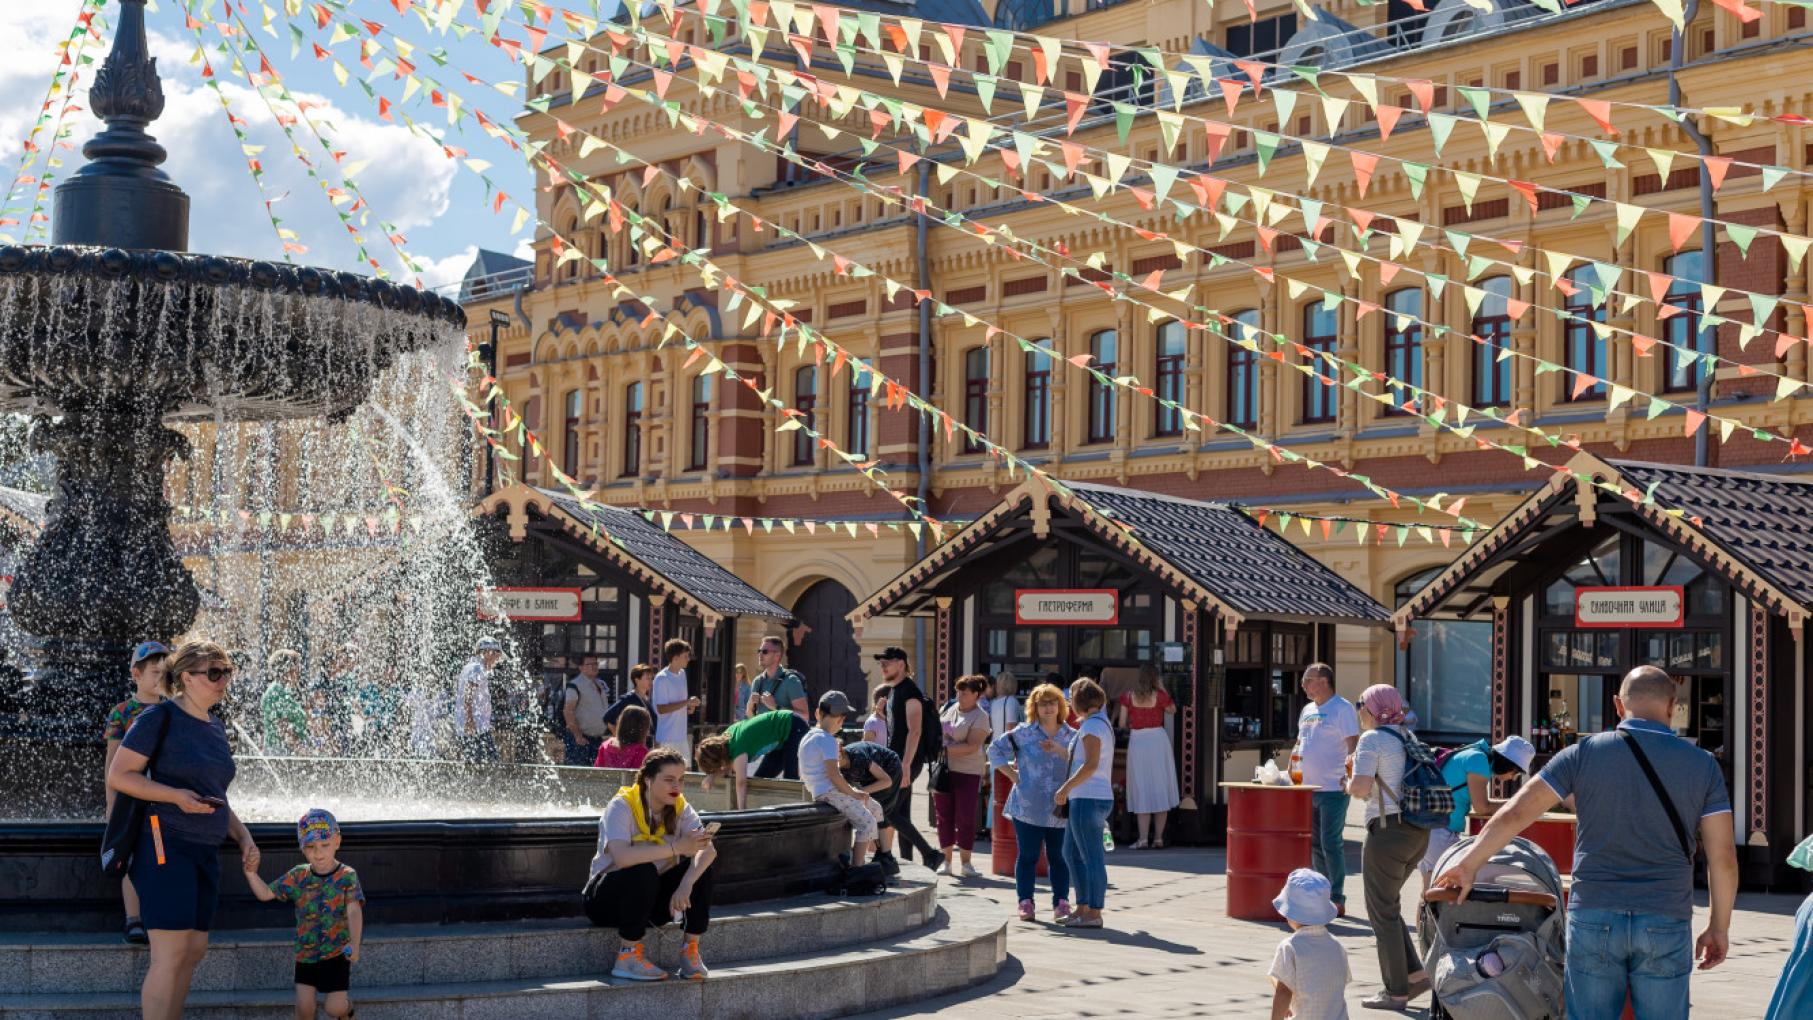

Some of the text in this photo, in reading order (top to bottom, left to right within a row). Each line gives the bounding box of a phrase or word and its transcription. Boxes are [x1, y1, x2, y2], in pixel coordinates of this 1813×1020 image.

[1038, 600, 1093, 613] ГАСТРОФЕРМА
[1590, 600, 1667, 614] СЛИВОЧНАЯ УЛИЦА
